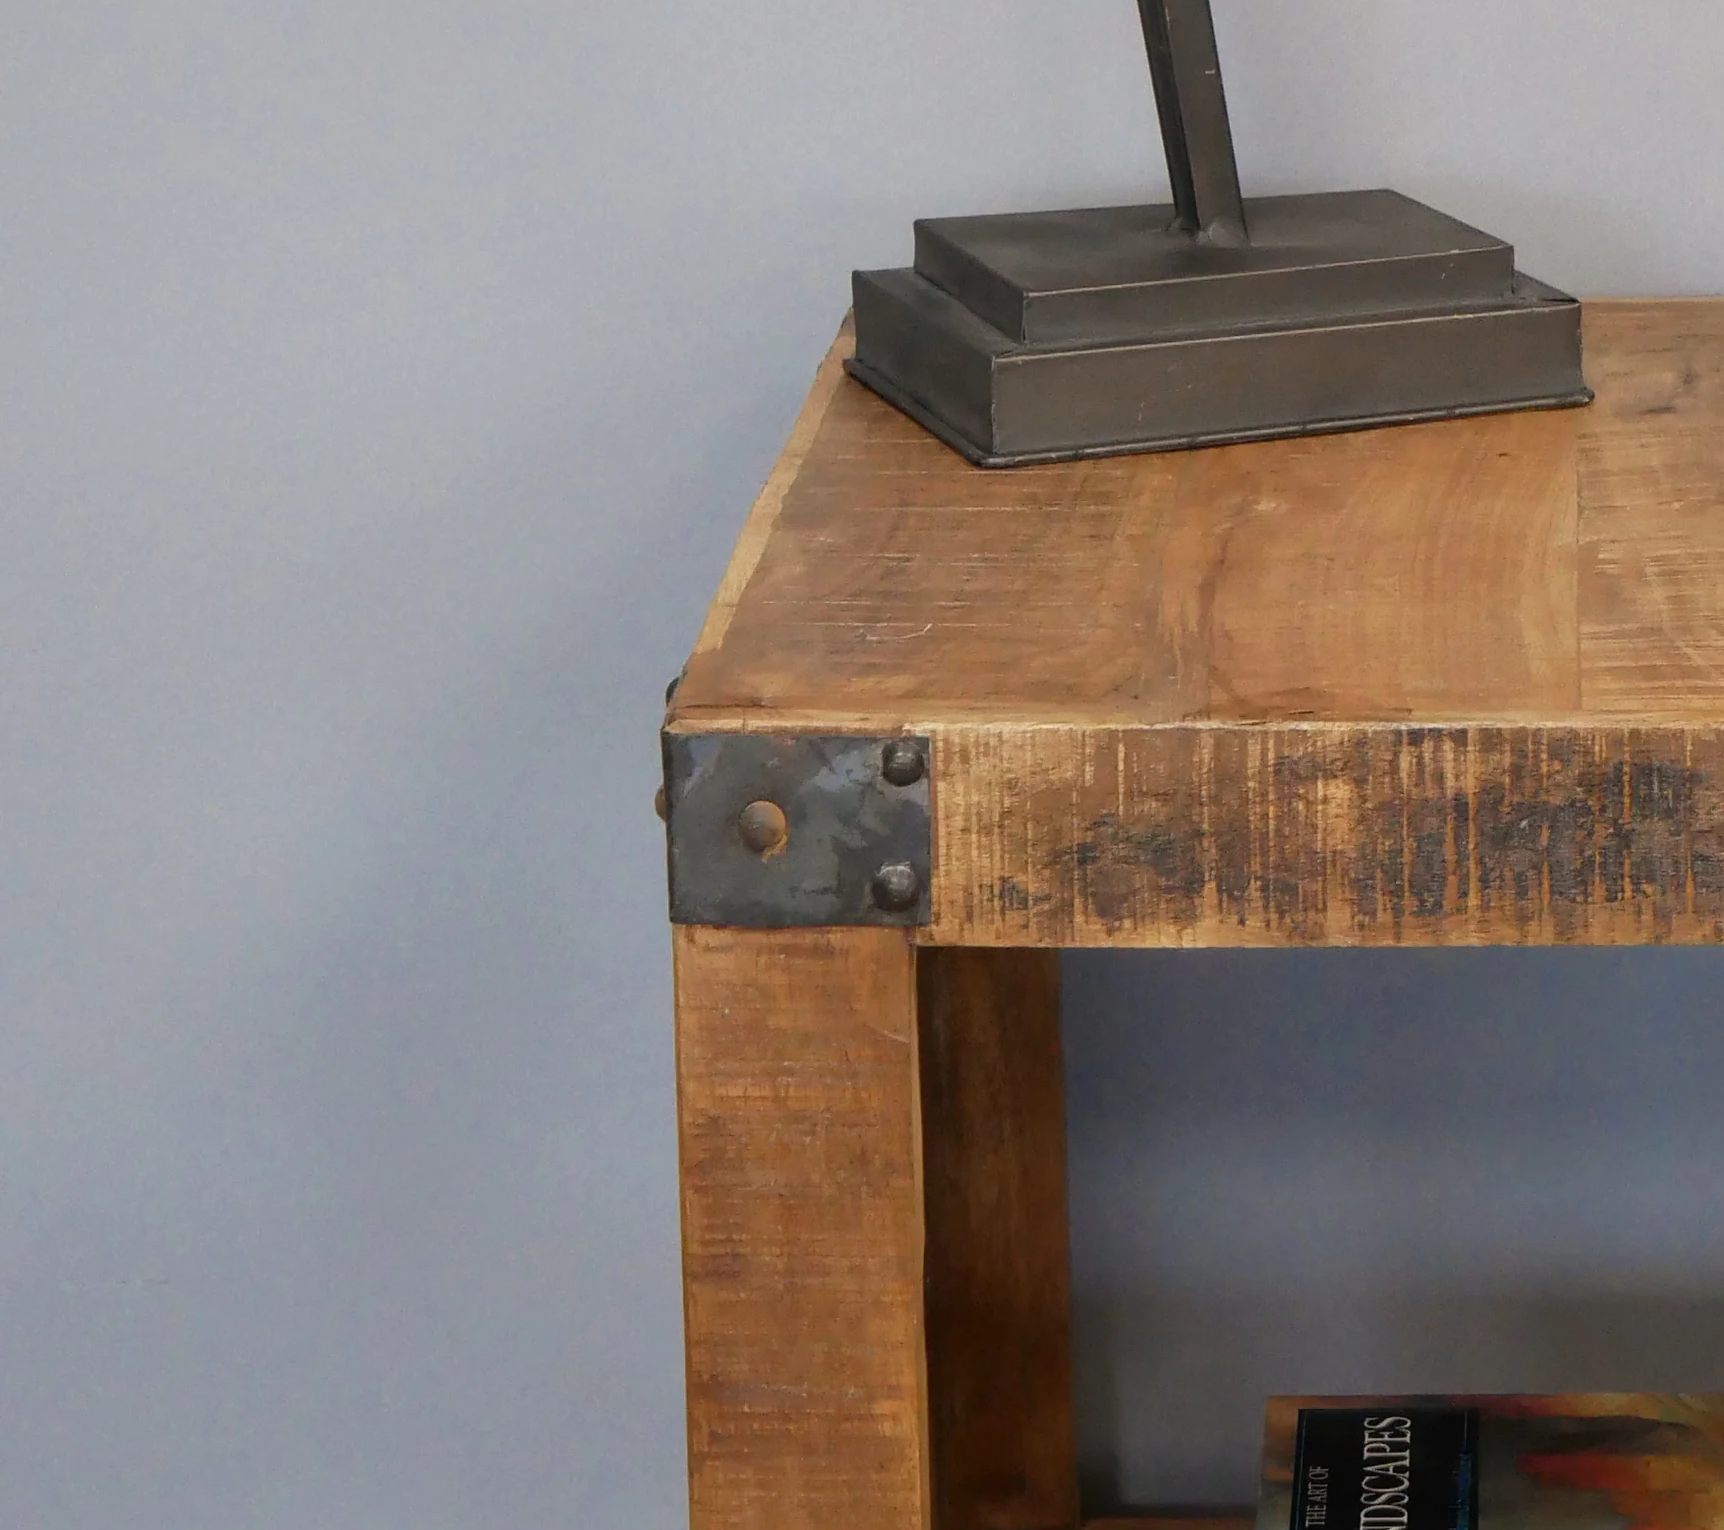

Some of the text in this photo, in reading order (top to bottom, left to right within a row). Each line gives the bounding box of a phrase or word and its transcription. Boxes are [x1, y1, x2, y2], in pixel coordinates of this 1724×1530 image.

[1305, 1465, 1329, 1528] THE ART OF
